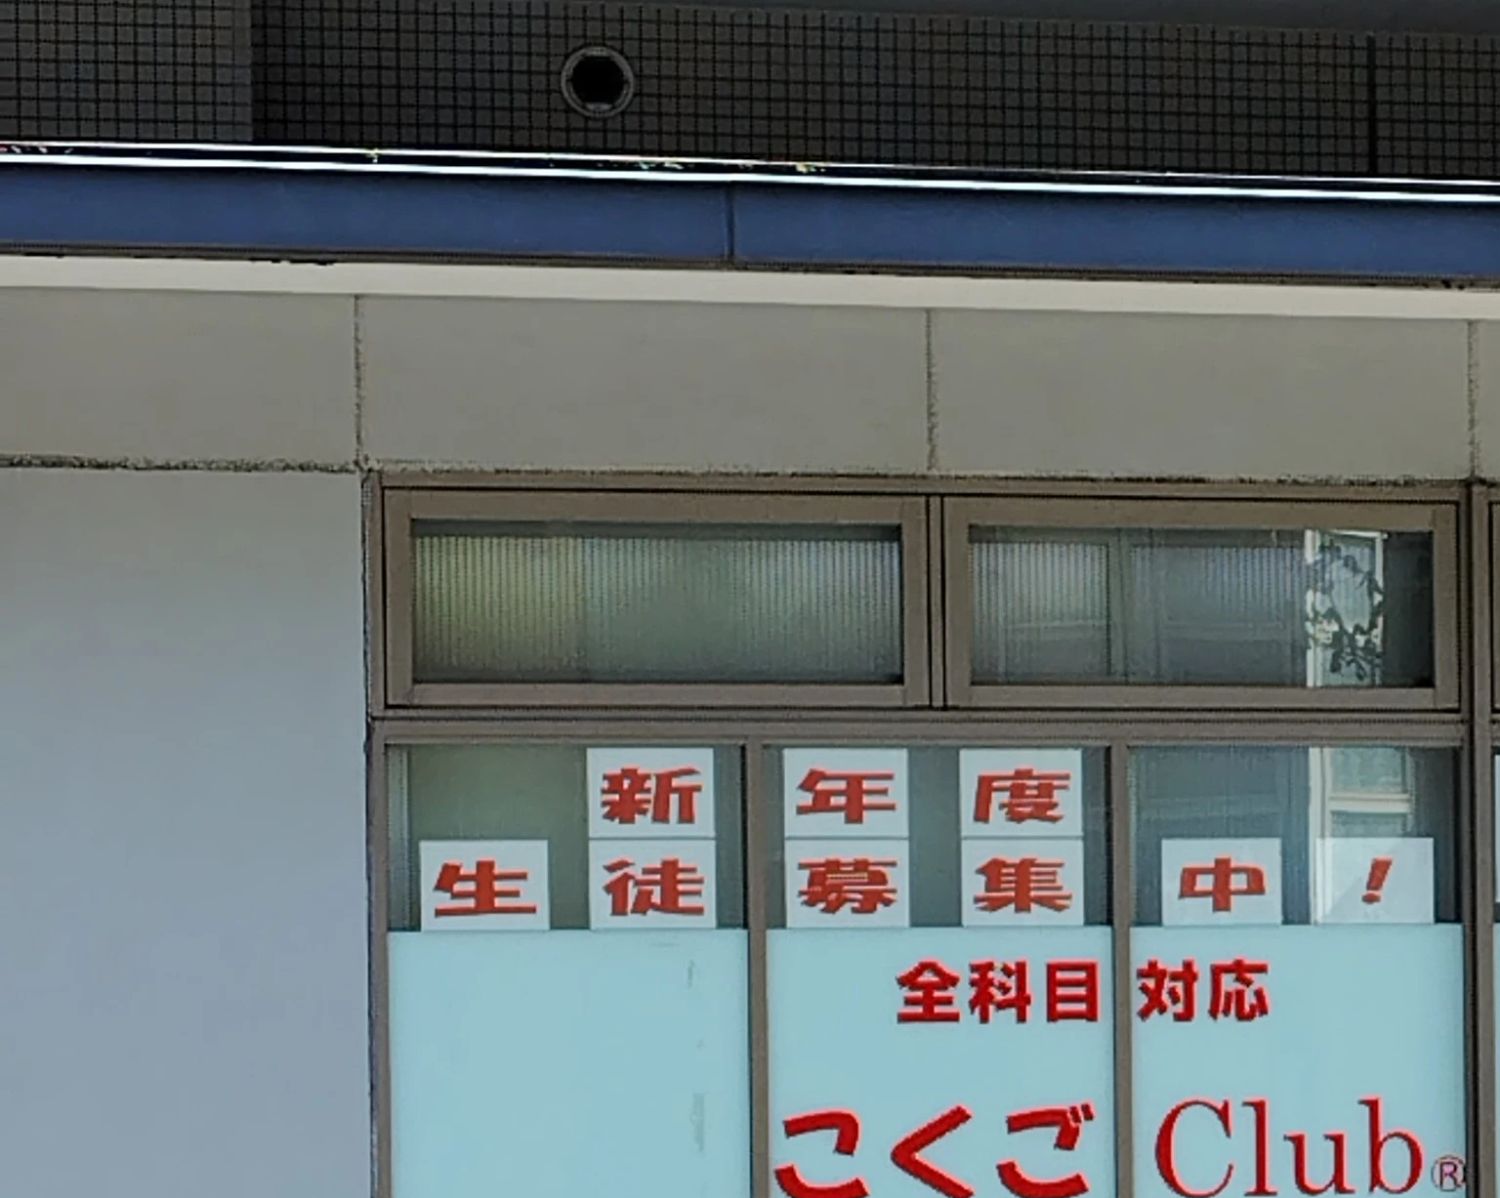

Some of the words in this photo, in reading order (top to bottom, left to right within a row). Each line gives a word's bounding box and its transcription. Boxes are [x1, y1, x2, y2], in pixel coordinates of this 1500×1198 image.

[600, 766, 1070, 823] 新年度
[899, 956, 1271, 1022] 全科目対応
